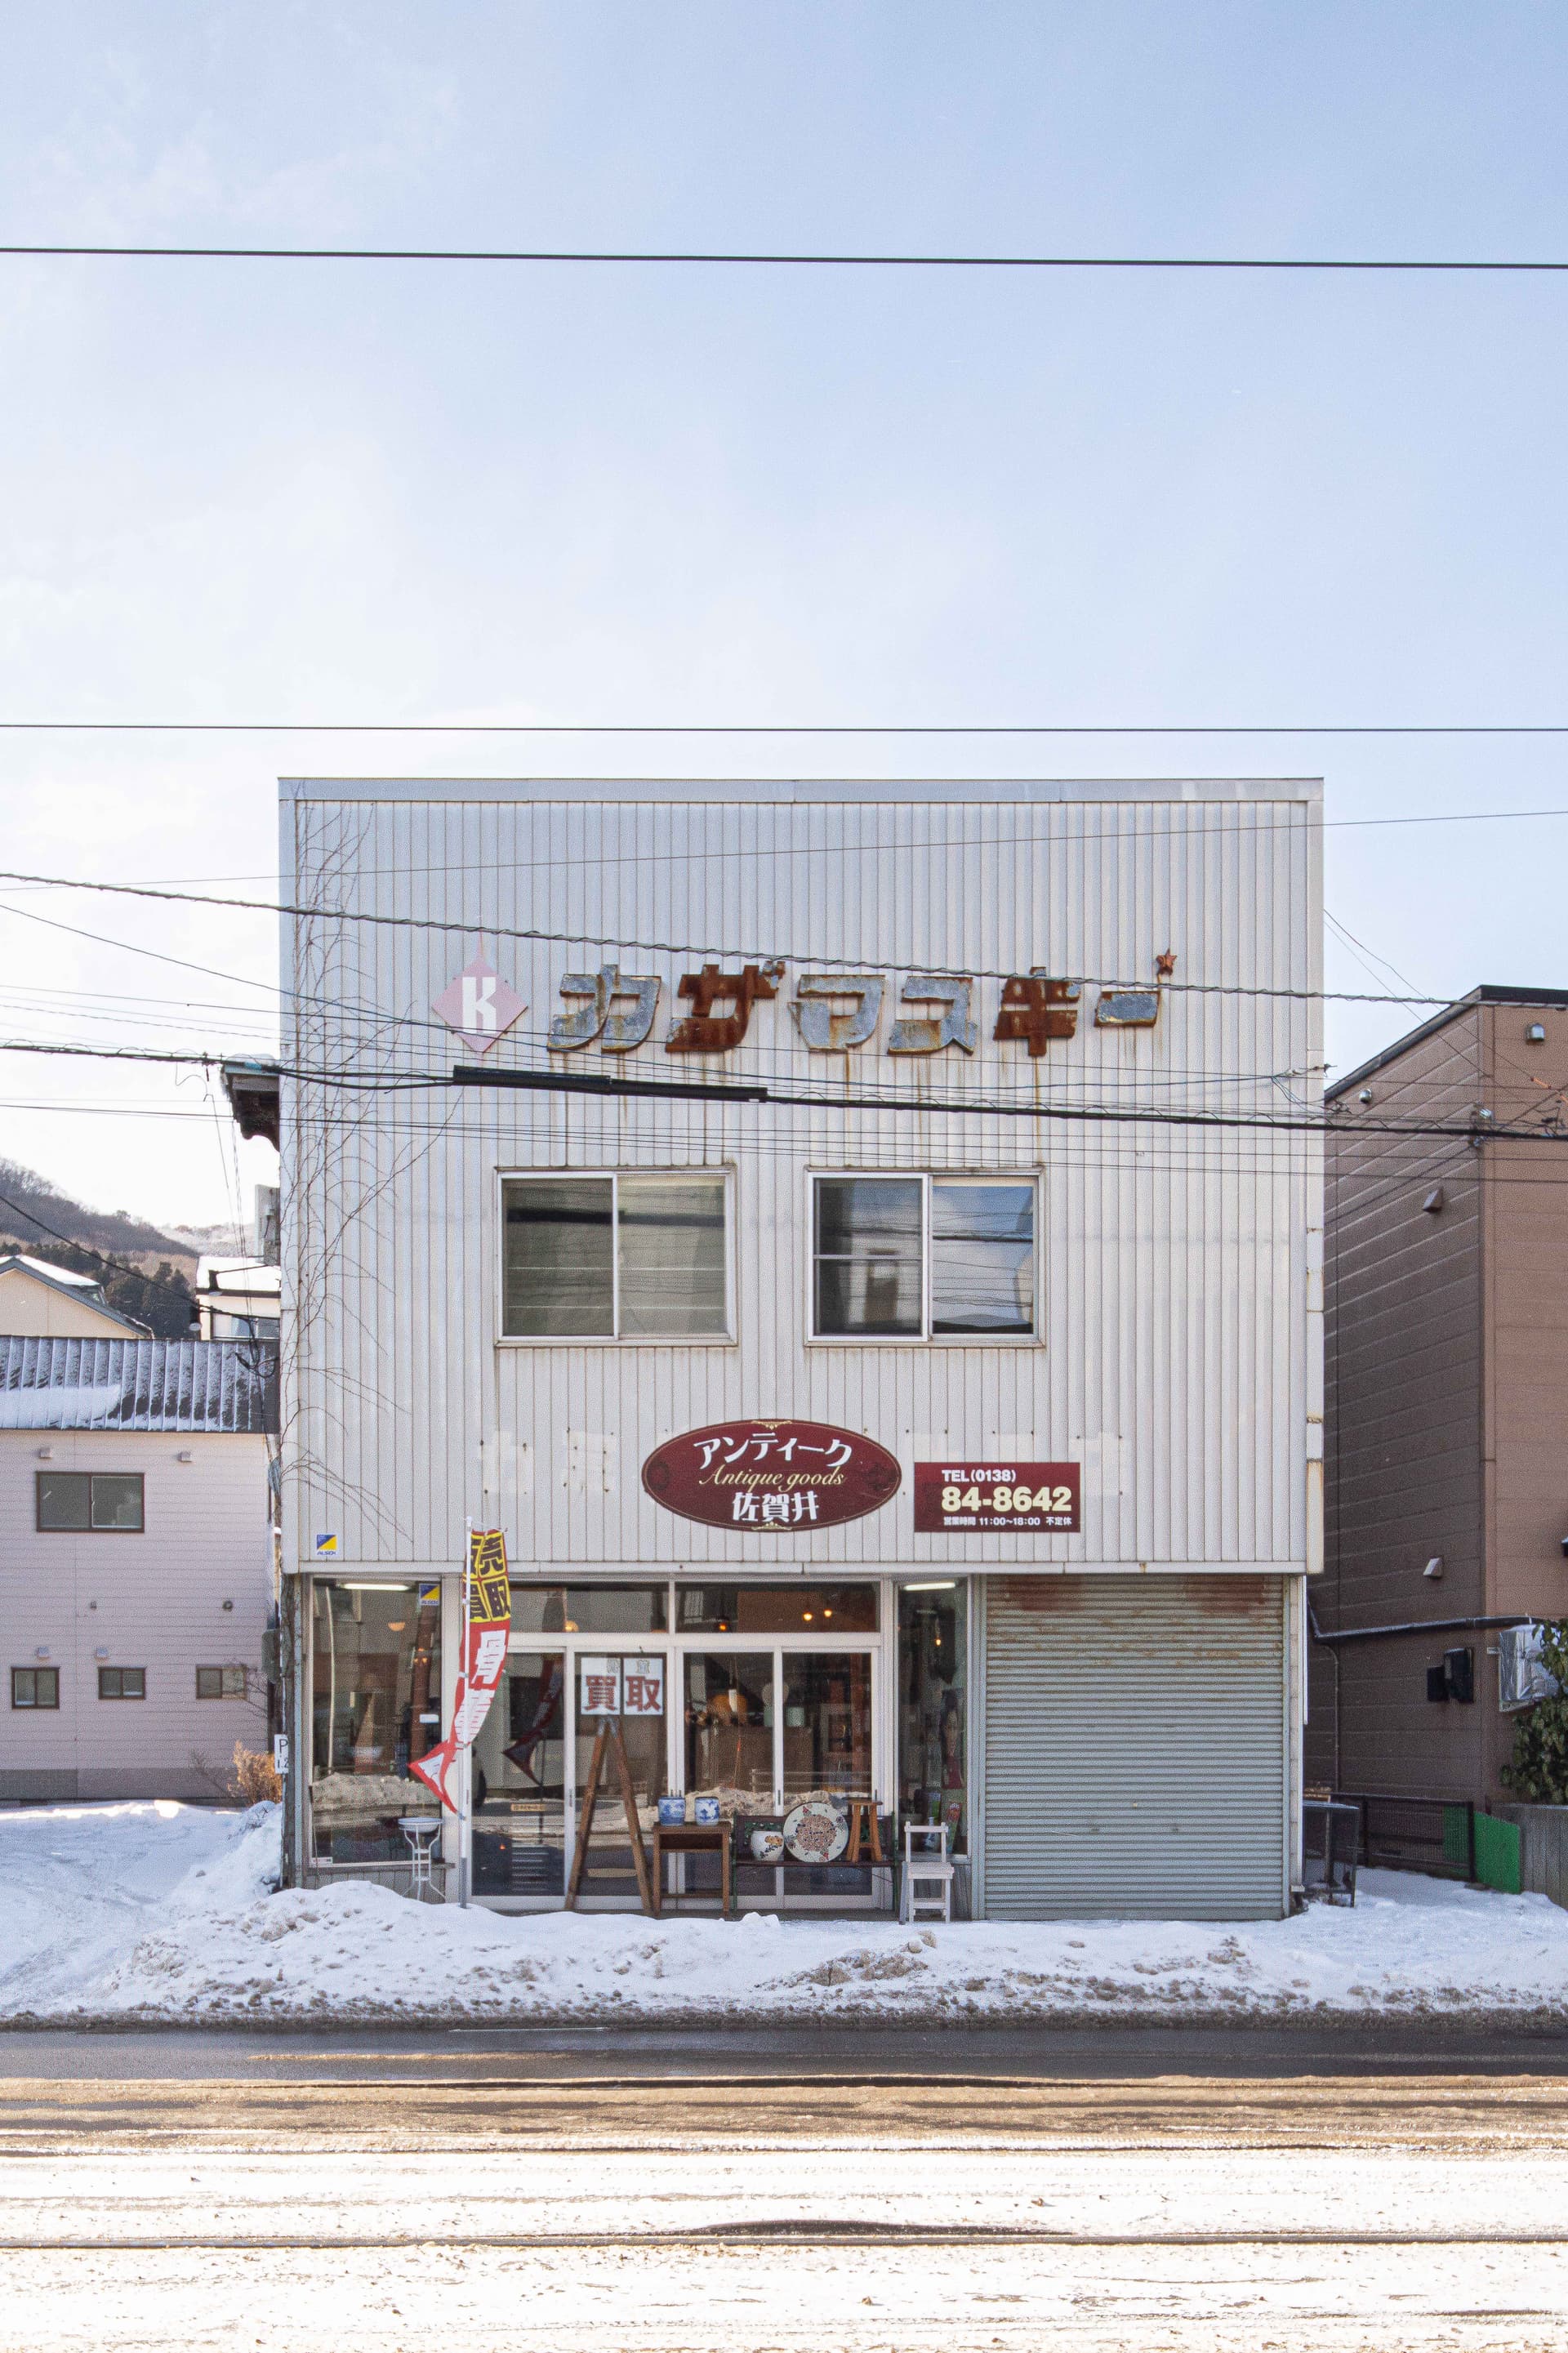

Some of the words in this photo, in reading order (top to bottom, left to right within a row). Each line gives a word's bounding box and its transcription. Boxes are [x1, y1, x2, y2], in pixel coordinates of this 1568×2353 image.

[462, 977, 497, 1034] K
[546, 960, 1160, 1056] カザマスキー
[693, 1433, 853, 1469] アンティーク
[698, 1464, 783, 1493] Antique
[777, 1464, 844, 1493] goods
[733, 1491, 819, 1523] 佐賀井
[942, 1486, 1072, 1512] 84-8642
[943, 1516, 976, 1526] 営業時間
[1046, 1516, 1072, 1526] 不定休
[584, 1675, 662, 1712] 買取
[278, 1738, 288, 1754] P
